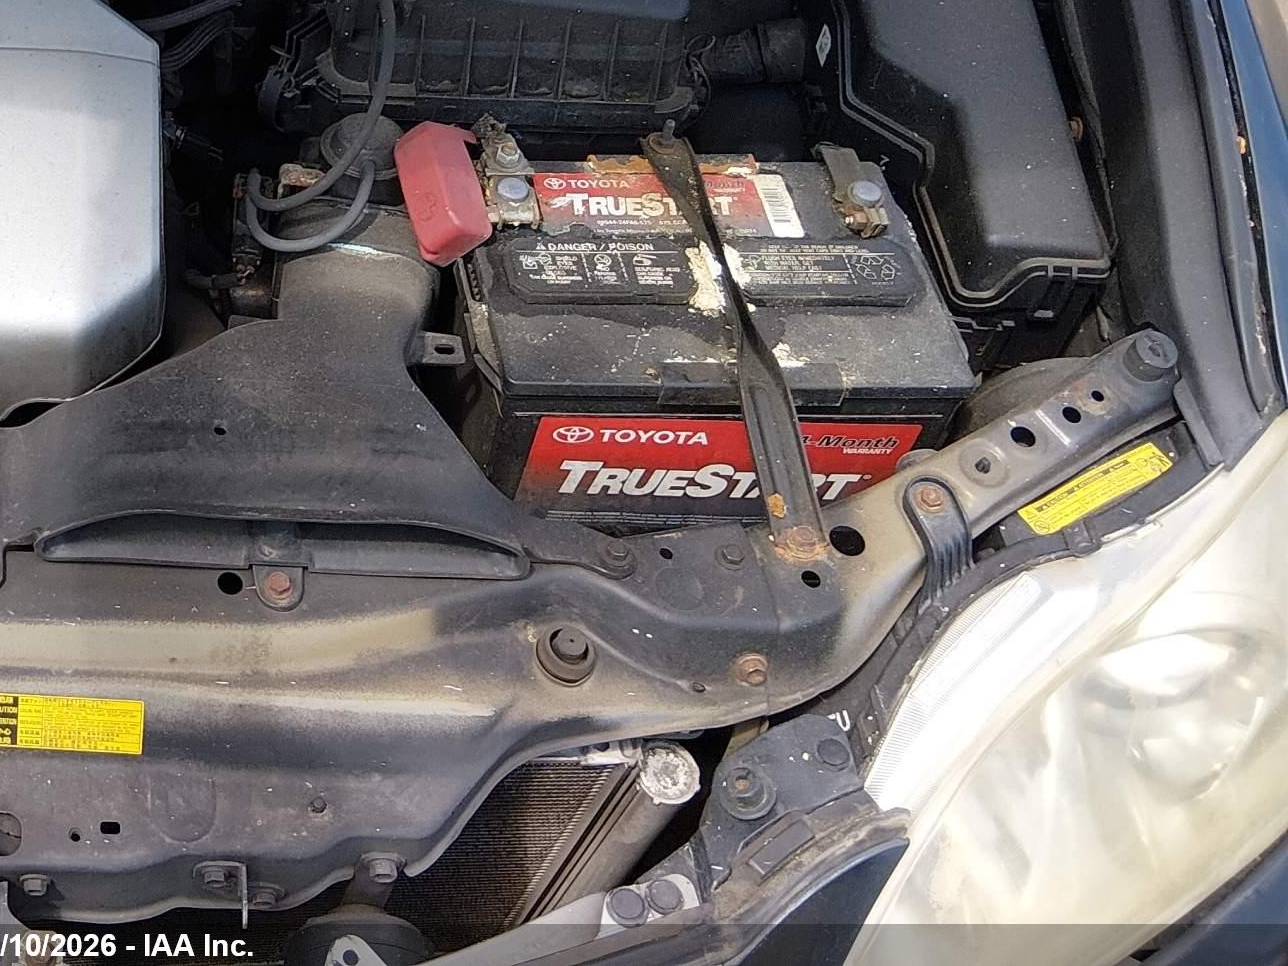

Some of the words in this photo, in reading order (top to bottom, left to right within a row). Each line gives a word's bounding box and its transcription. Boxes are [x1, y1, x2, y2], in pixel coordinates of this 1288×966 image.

[567, 179, 630, 189] TOYOTA
[548, 243, 596, 251] DANGER
[609, 243, 655, 251] POISON
[599, 429, 709, 445] TOYOTA
